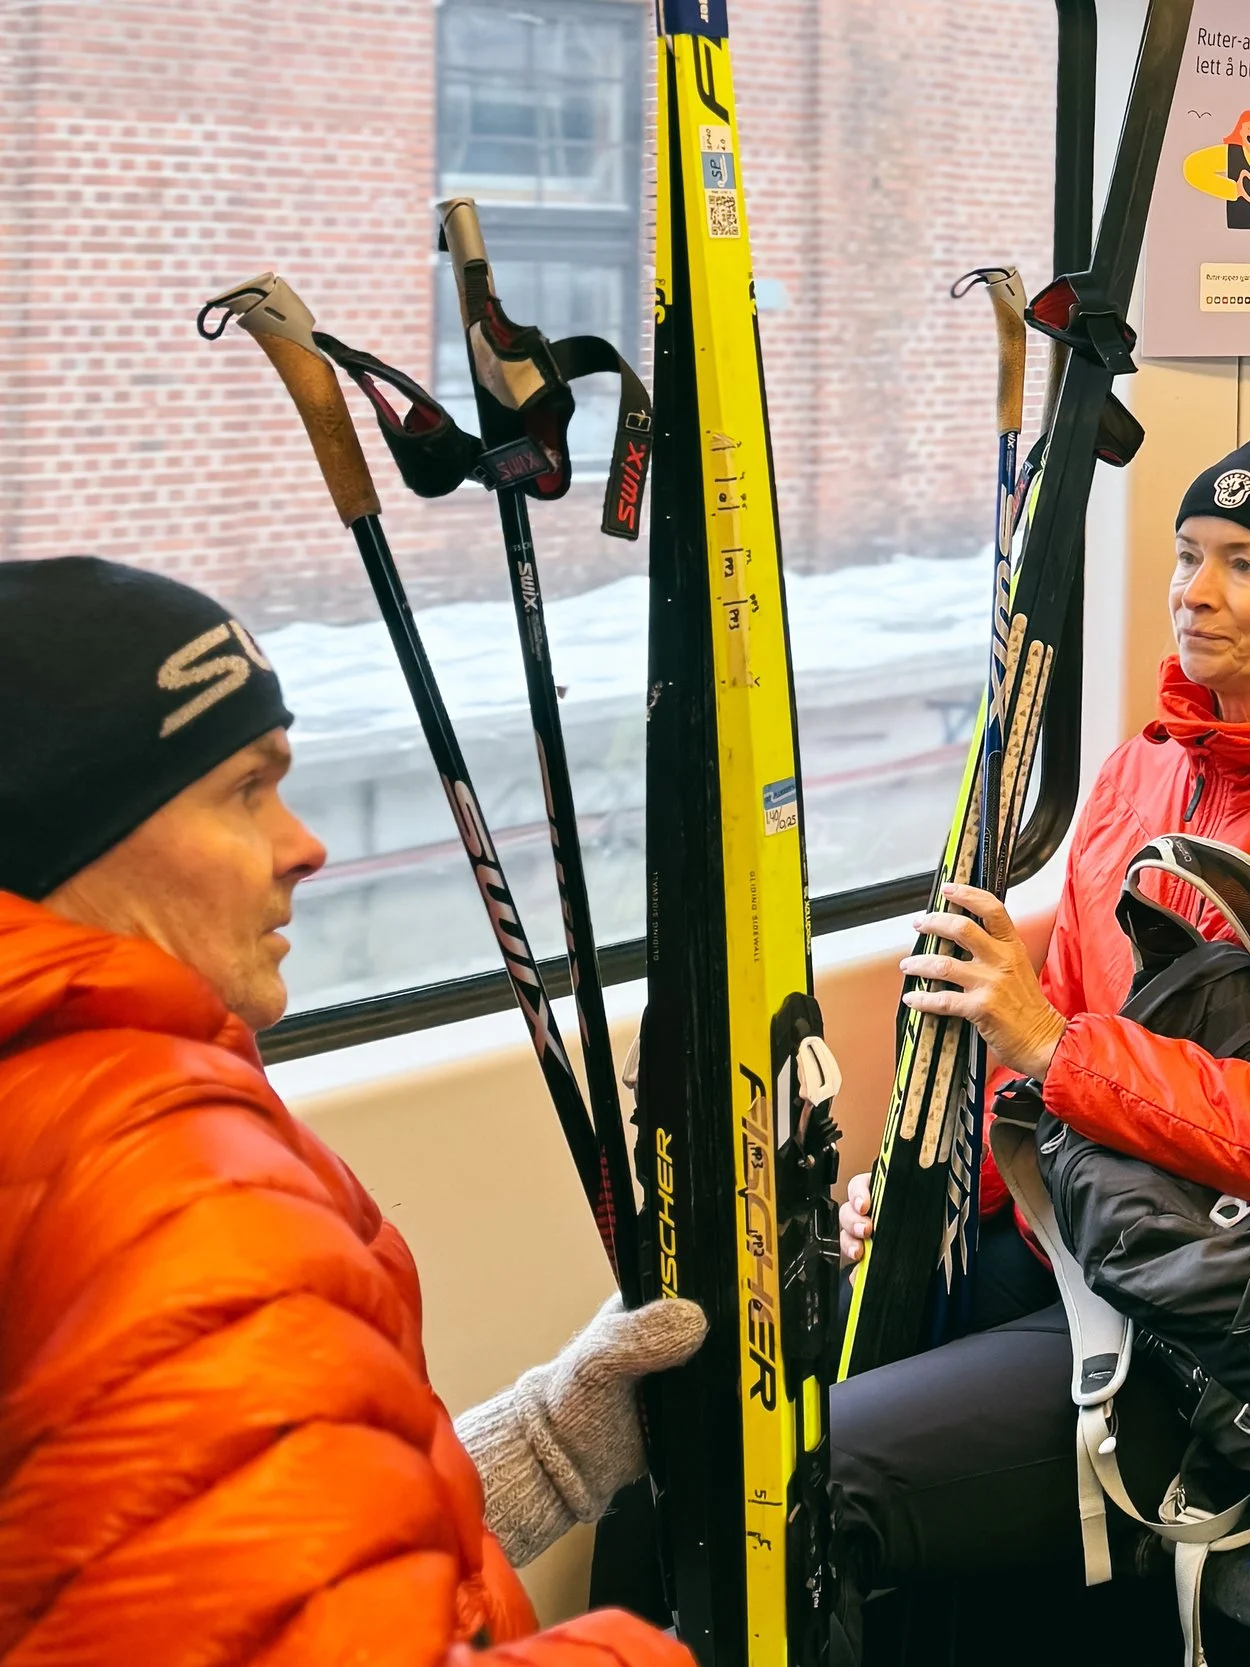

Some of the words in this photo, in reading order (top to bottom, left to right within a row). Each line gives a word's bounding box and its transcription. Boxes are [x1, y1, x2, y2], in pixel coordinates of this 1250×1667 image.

[1196, 56, 1221, 75] lett
[1225, 57, 1234, 77] å
[728, 608, 740, 631] PP3
[739, 1062, 777, 1412] FISCHER
